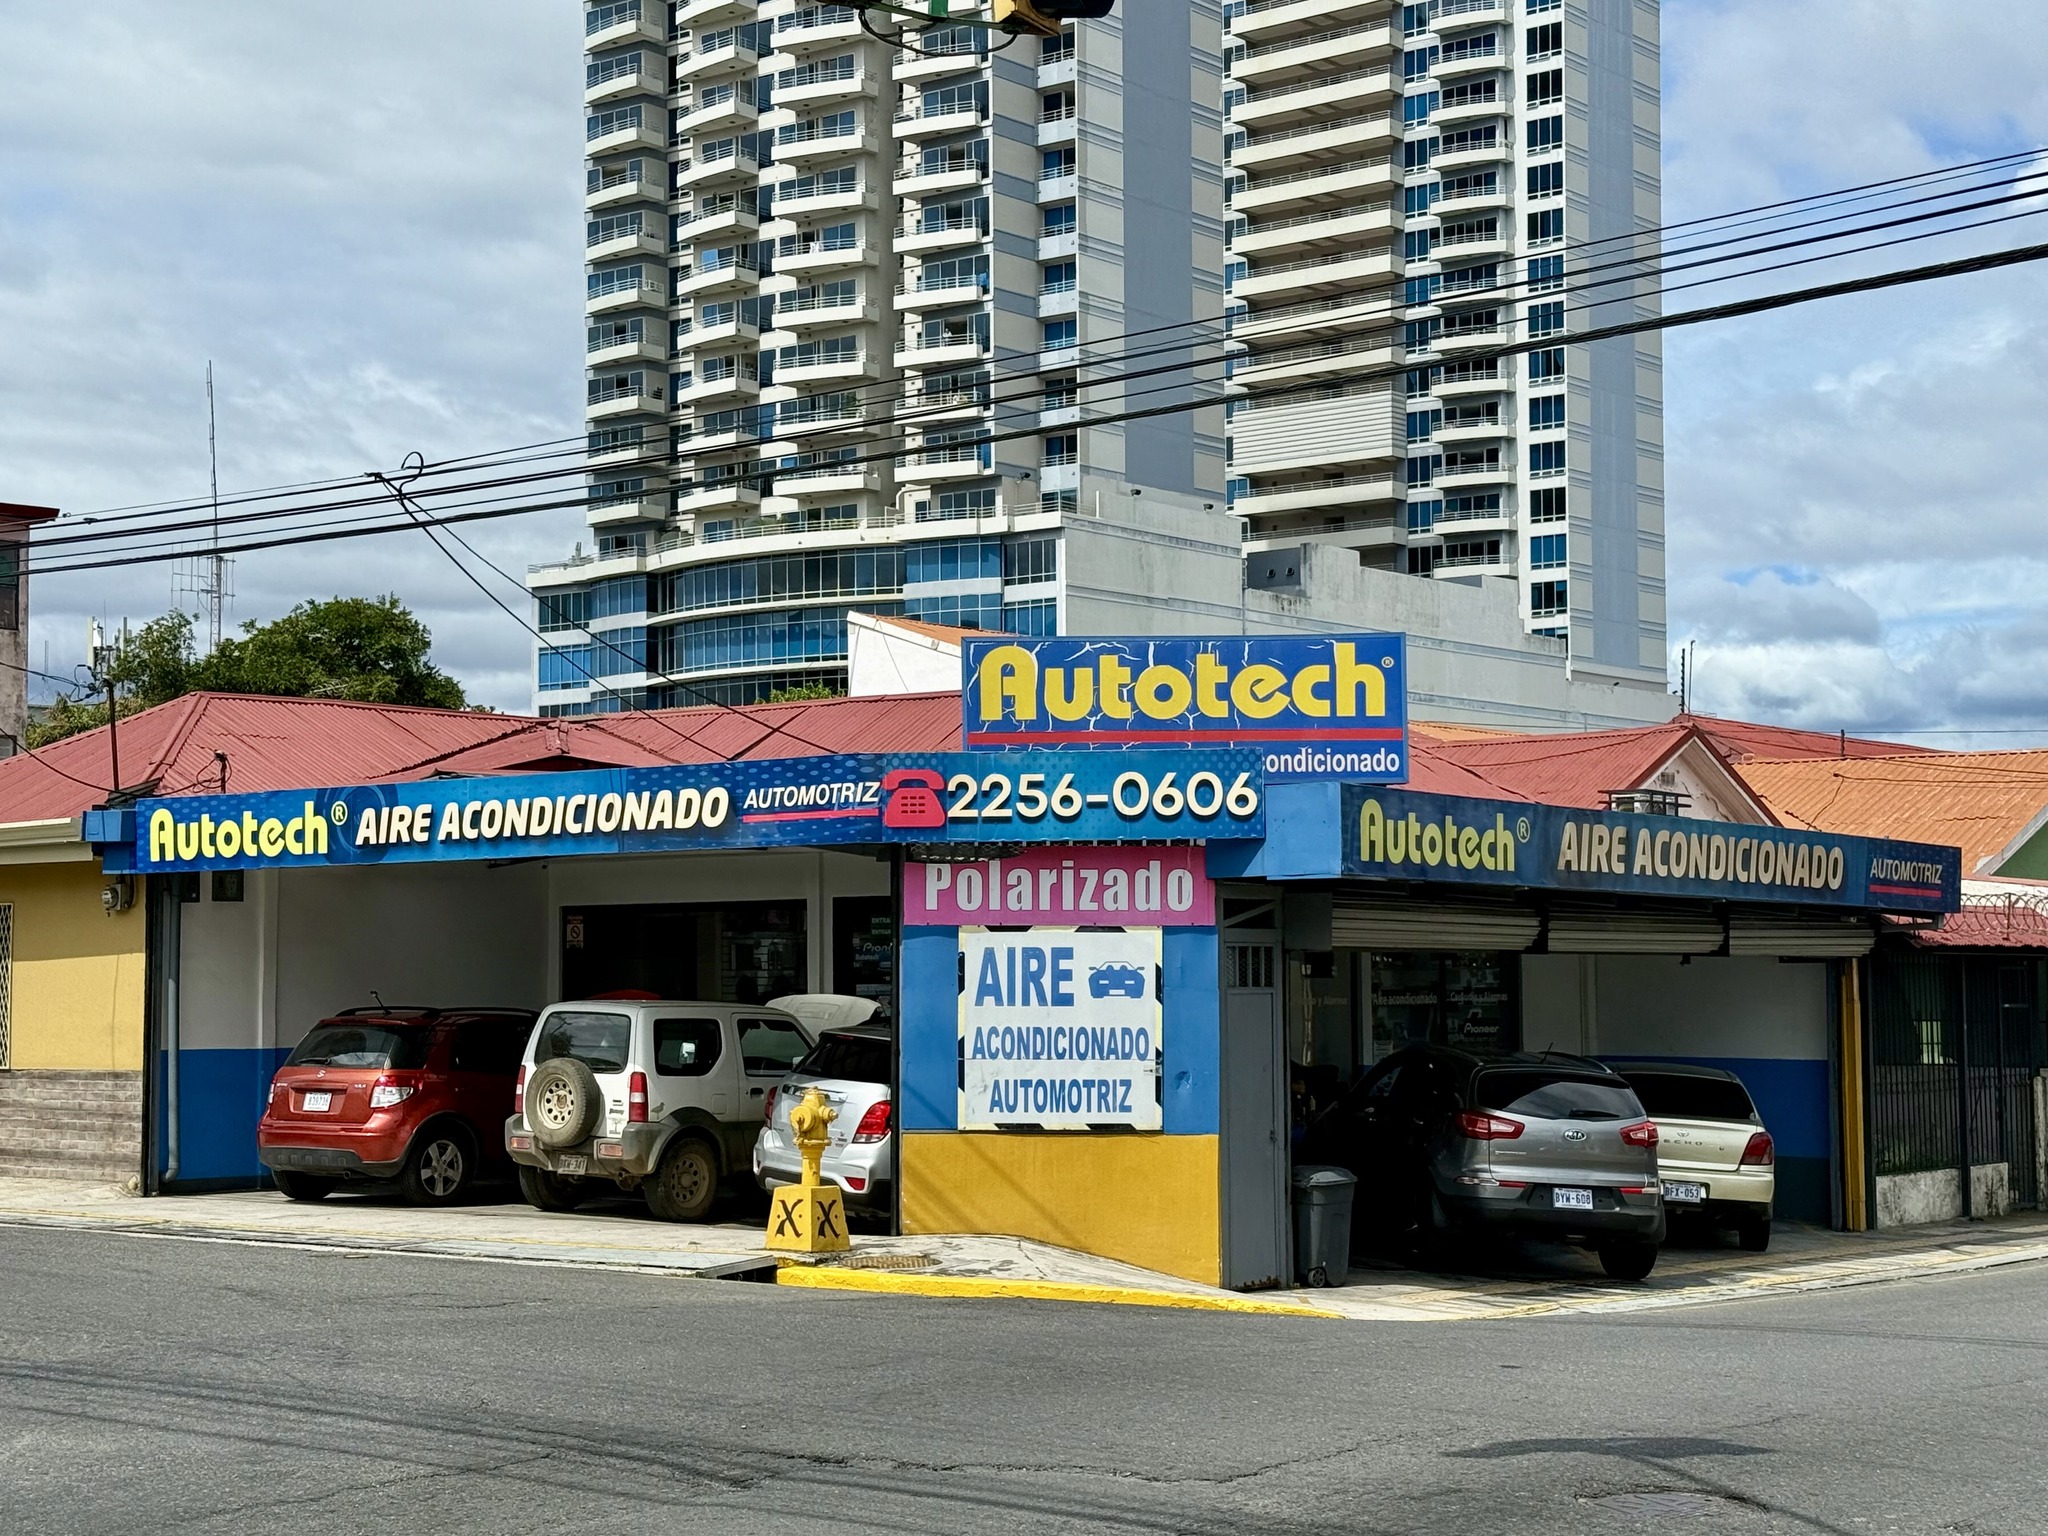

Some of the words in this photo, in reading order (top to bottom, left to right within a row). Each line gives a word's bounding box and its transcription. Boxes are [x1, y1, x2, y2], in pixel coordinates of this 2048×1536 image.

[1262, 747, 1400, 773] ondicionado
[355, 803, 432, 846] AIRE
[437, 786, 729, 842] ACONDICIONADO
[743, 780, 882, 810] AUTOMOTRIZ
[947, 771, 1258, 819] 2256-0606
[1557, 821, 1628, 875] AIRE
[1633, 827, 1845, 891] ACONDICIONADO
[1869, 857, 1943, 885] AUTOMOTRIZ
[925, 859, 1194, 912] Polarizado
[975, 947, 1075, 1007] AIRE
[972, 1026, 1150, 1061] ACONDICIONADO
[989, 1078, 1133, 1113] AUTOMOTRIZ
[1664, 1186, 1699, 1199] BFX-053
